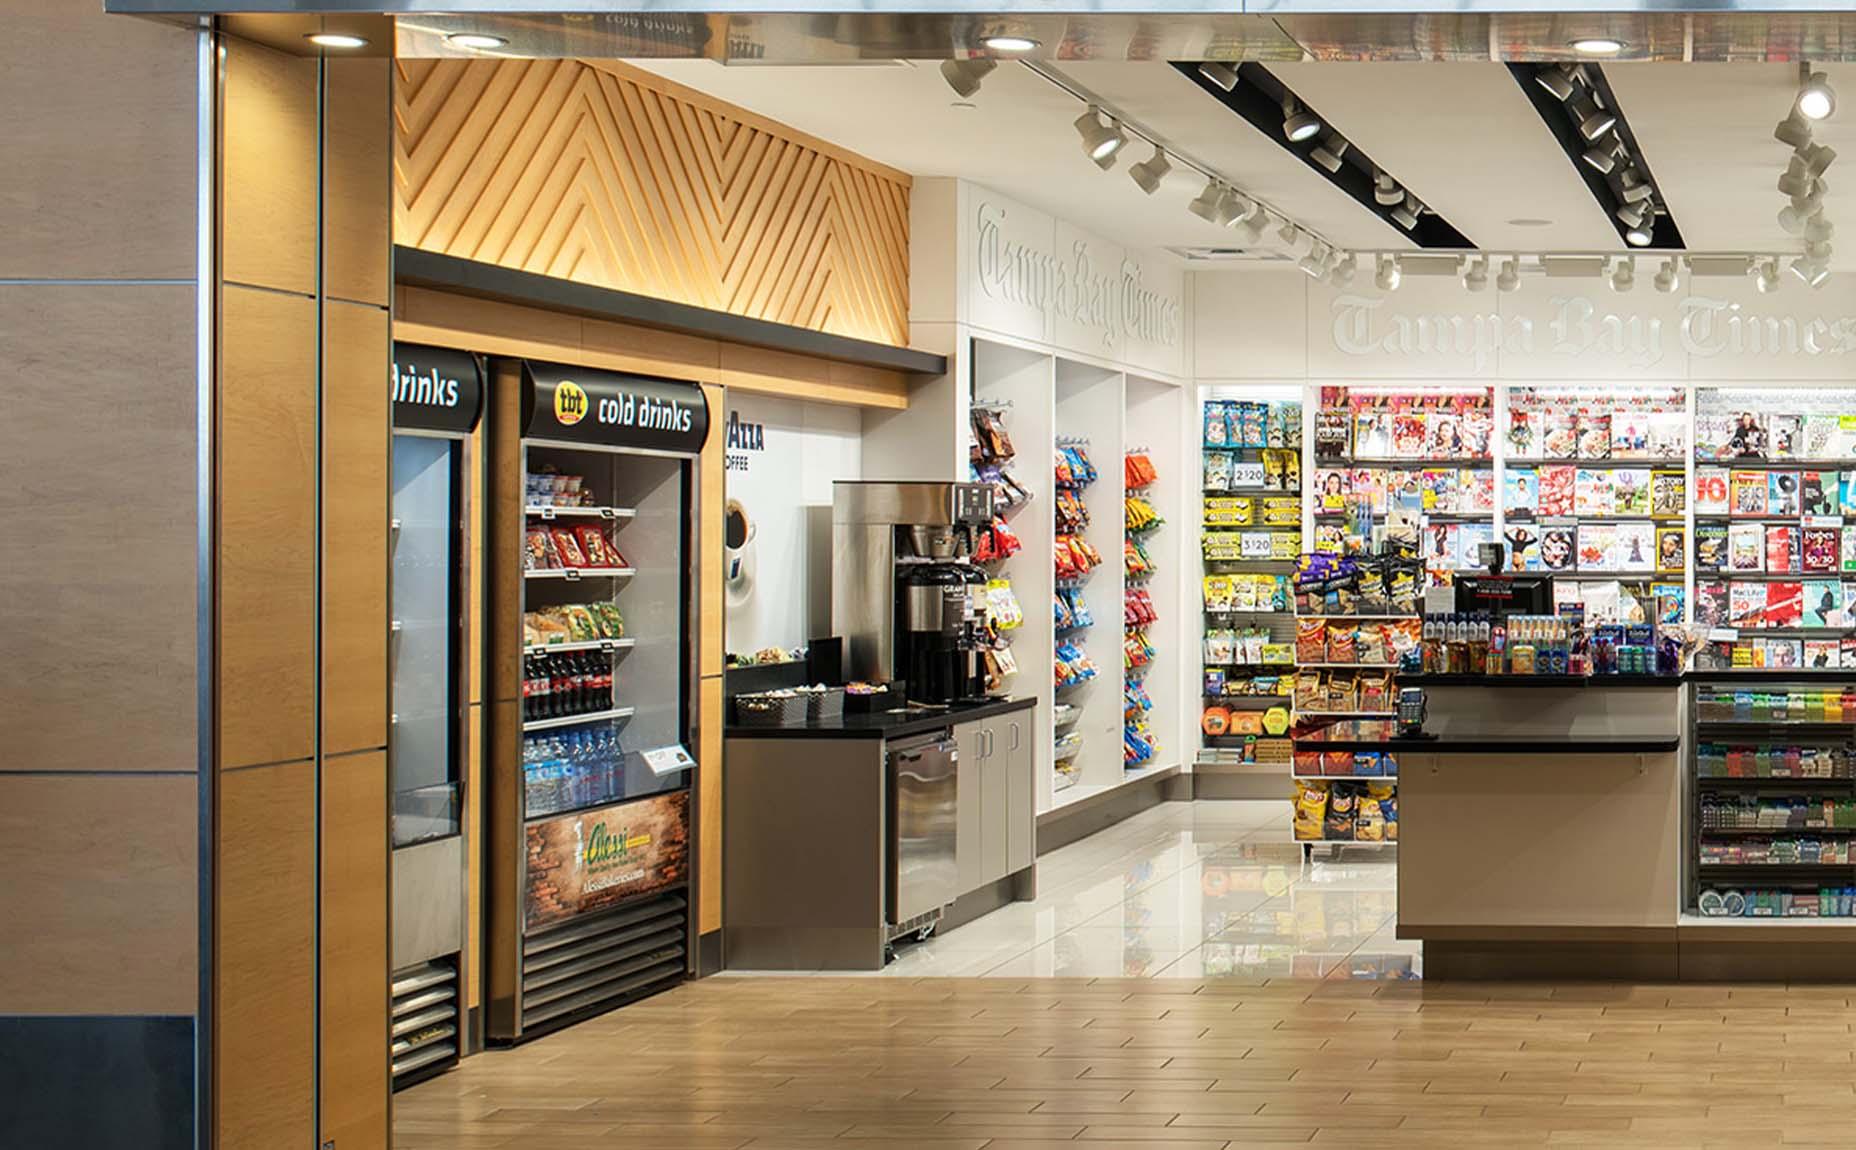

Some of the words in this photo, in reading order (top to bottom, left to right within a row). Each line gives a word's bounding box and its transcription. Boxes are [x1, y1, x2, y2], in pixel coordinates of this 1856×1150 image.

[978, 202, 1067, 340] Tampa
[1072, 240, 1116, 349] Bay
[1120, 256, 1178, 347] Times
[1330, 293, 1534, 375] Tampa
[1549, 295, 1664, 368] Bay
[598, 393, 634, 427] cold
[639, 395, 692, 433] drinks
[726, 411, 764, 451] AZZA
